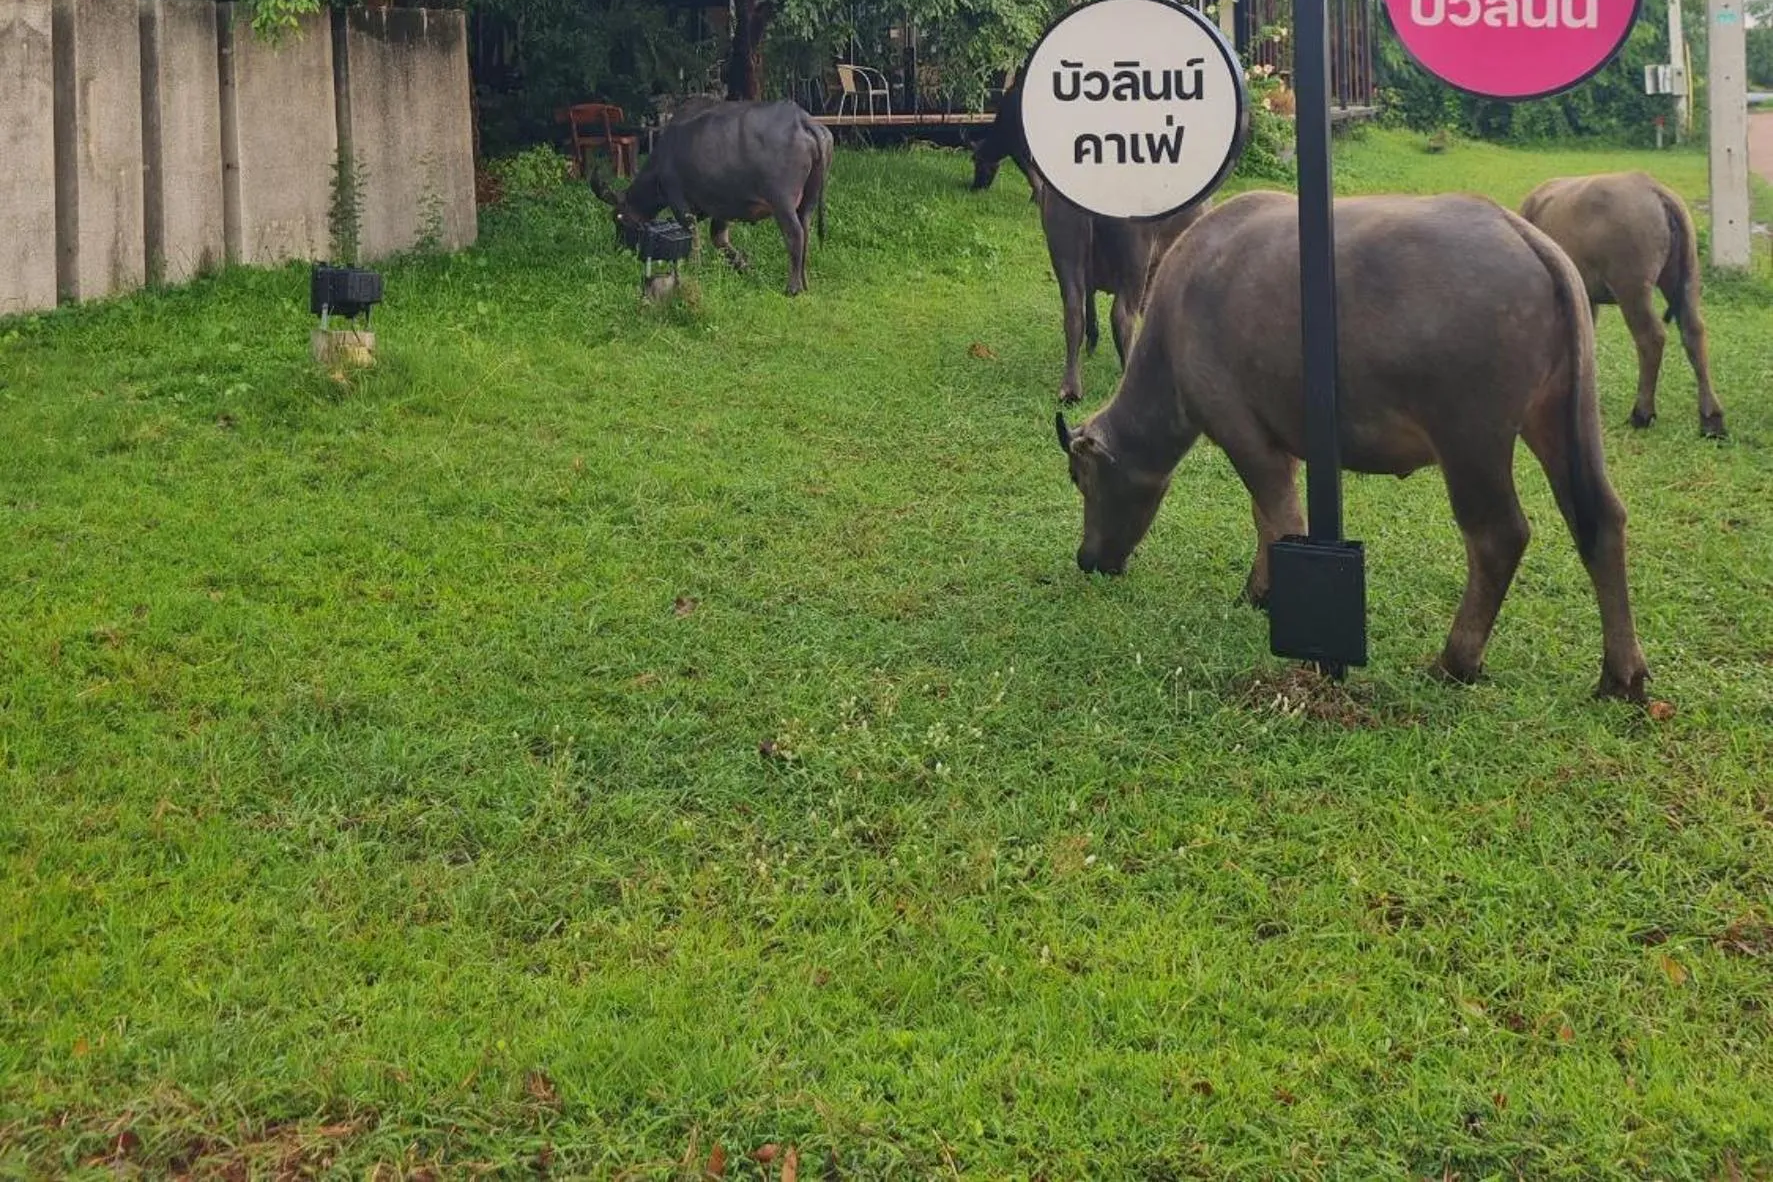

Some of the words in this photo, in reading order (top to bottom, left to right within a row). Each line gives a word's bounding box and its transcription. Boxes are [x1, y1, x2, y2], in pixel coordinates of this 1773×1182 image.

[1053, 58, 1204, 101] บัวลินน์
[1074, 115, 1184, 164] คาเฟ่
